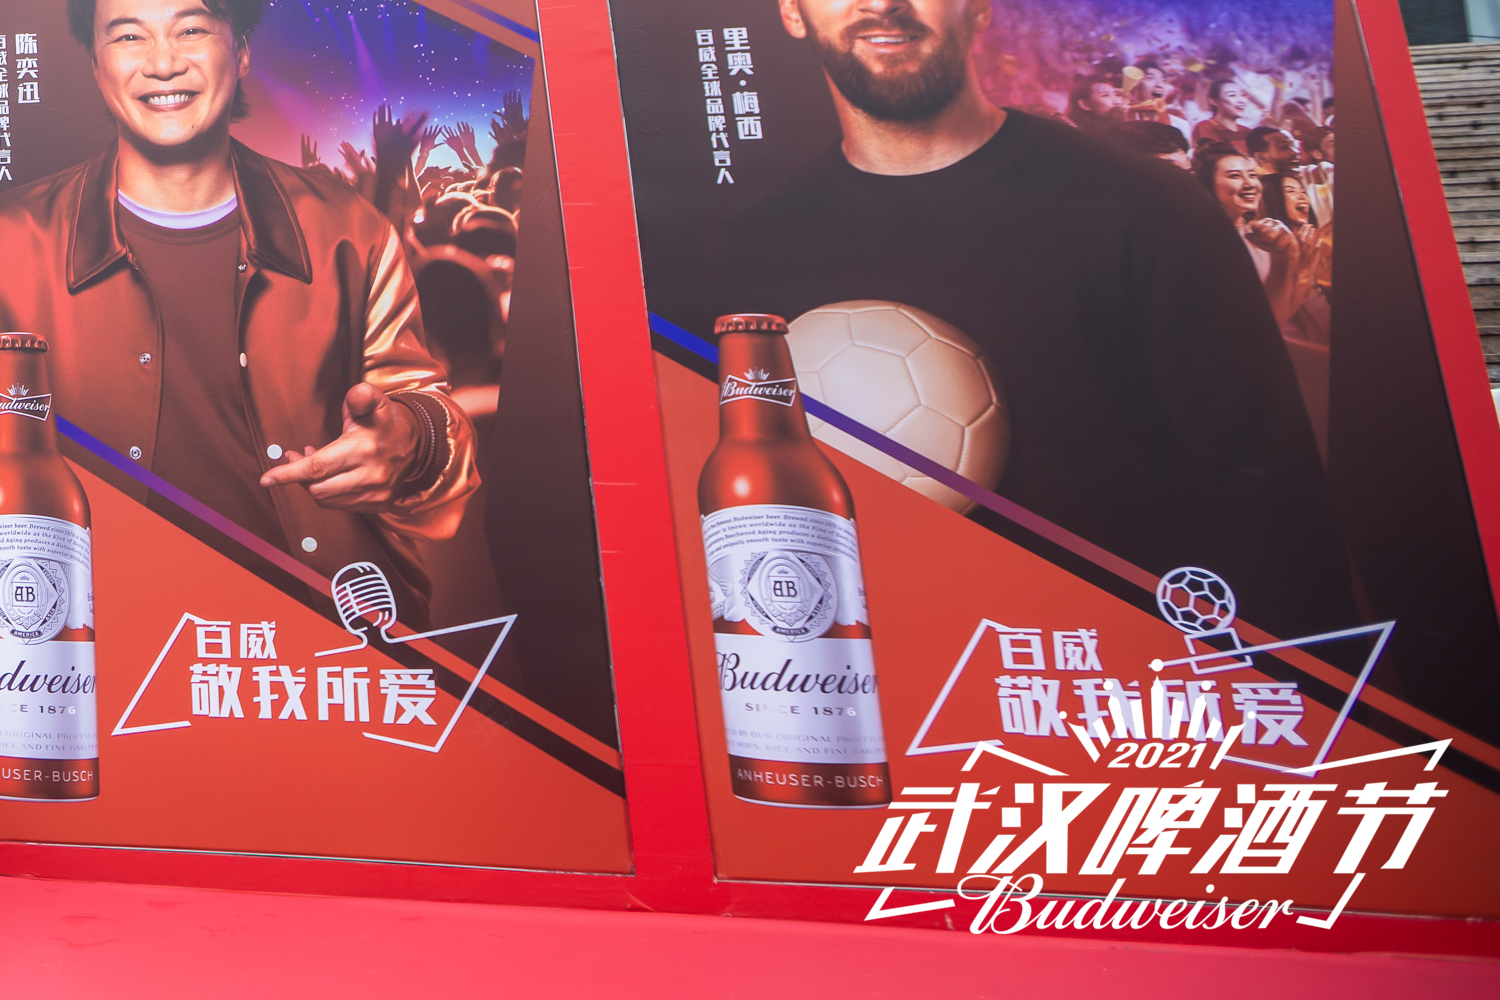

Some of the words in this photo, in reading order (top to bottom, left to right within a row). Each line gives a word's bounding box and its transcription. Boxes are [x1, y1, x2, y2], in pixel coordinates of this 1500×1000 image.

[15, 33, 40, 104] 陈奕迅
[723, 27, 763, 140] 里奥·梅西
[695, 29, 734, 184] 百威全球品牌代言人
[723, 382, 795, 397] Budweiser
[725, 530, 756, 539] Beechwood
[806, 541, 832, 549] superior
[47, 549, 69, 557] superior
[14, 586, 36, 602] AB
[774, 581, 798, 598] AB
[14, 630, 39, 638] AMERICA
[776, 627, 806, 635] AMERICA
[194, 621, 277, 659] 百威
[995, 628, 1103, 671] 百威
[716, 652, 878, 694] Budweiser
[190, 663, 437, 725] 敬我所爱
[39, 705, 76, 715] 1876
[813, 707, 857, 717] 1876
[5, 730, 54, 739] ORIGINAL
[776, 733, 833, 743] ORIGINAL
[795, 746, 820, 754] AND
[824, 747, 848, 755] FINE
[737, 768, 883, 788] ANHEUSER-BUSCH
